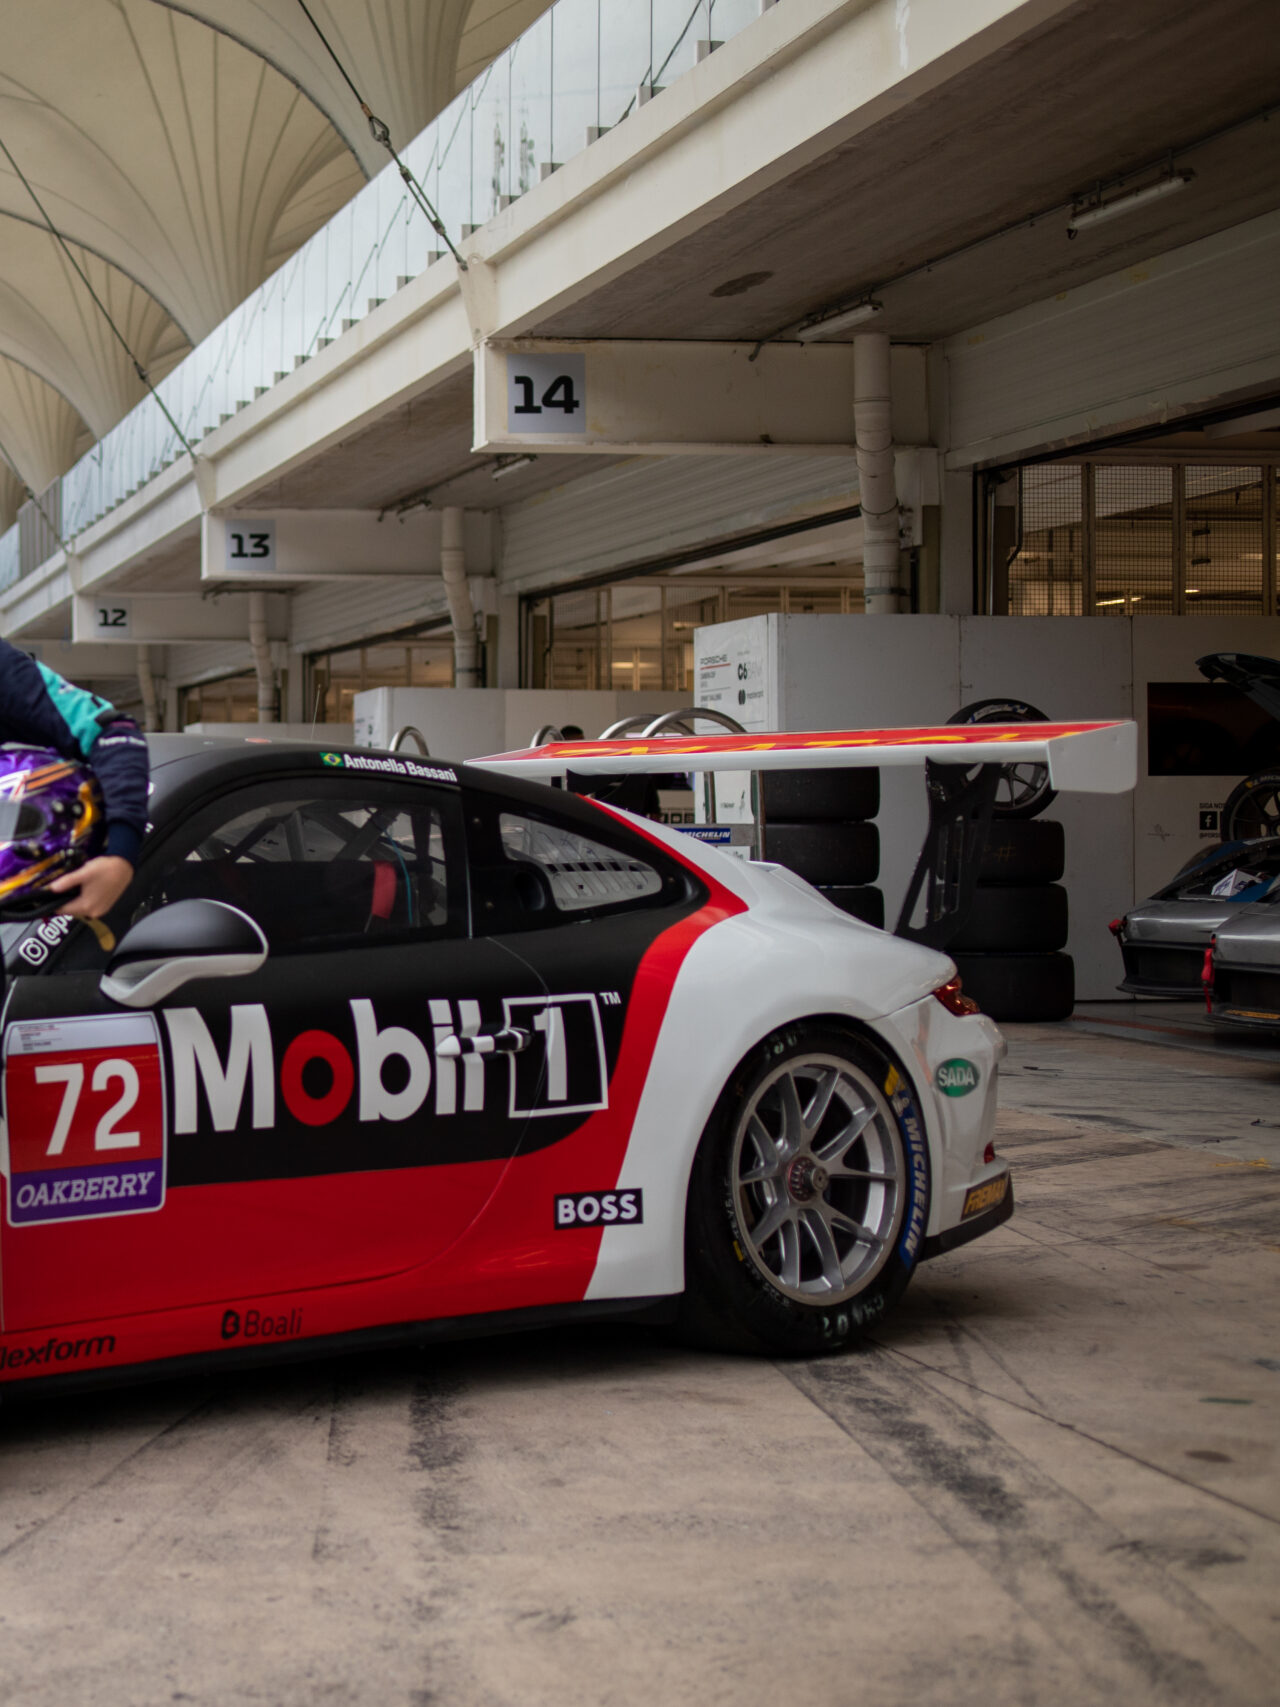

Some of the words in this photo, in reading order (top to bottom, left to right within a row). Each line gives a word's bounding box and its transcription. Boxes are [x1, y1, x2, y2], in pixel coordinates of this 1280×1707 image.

[514, 375, 579, 414] 14
[230, 533, 270, 558] 13
[98, 608, 127, 627] 12
[343, 753, 407, 774] Antonella
[405, 760, 458, 782] Bassani
[162, 997, 485, 1134] Mobil
[937, 1066, 976, 1088] SADA
[34, 1058, 140, 1156] 72
[16, 1171, 155, 1208] OAKBERRY
[903, 1116, 928, 1257] MICHELIN
[558, 1193, 637, 1224] BOSS
[244, 1308, 303, 1337] Boali
